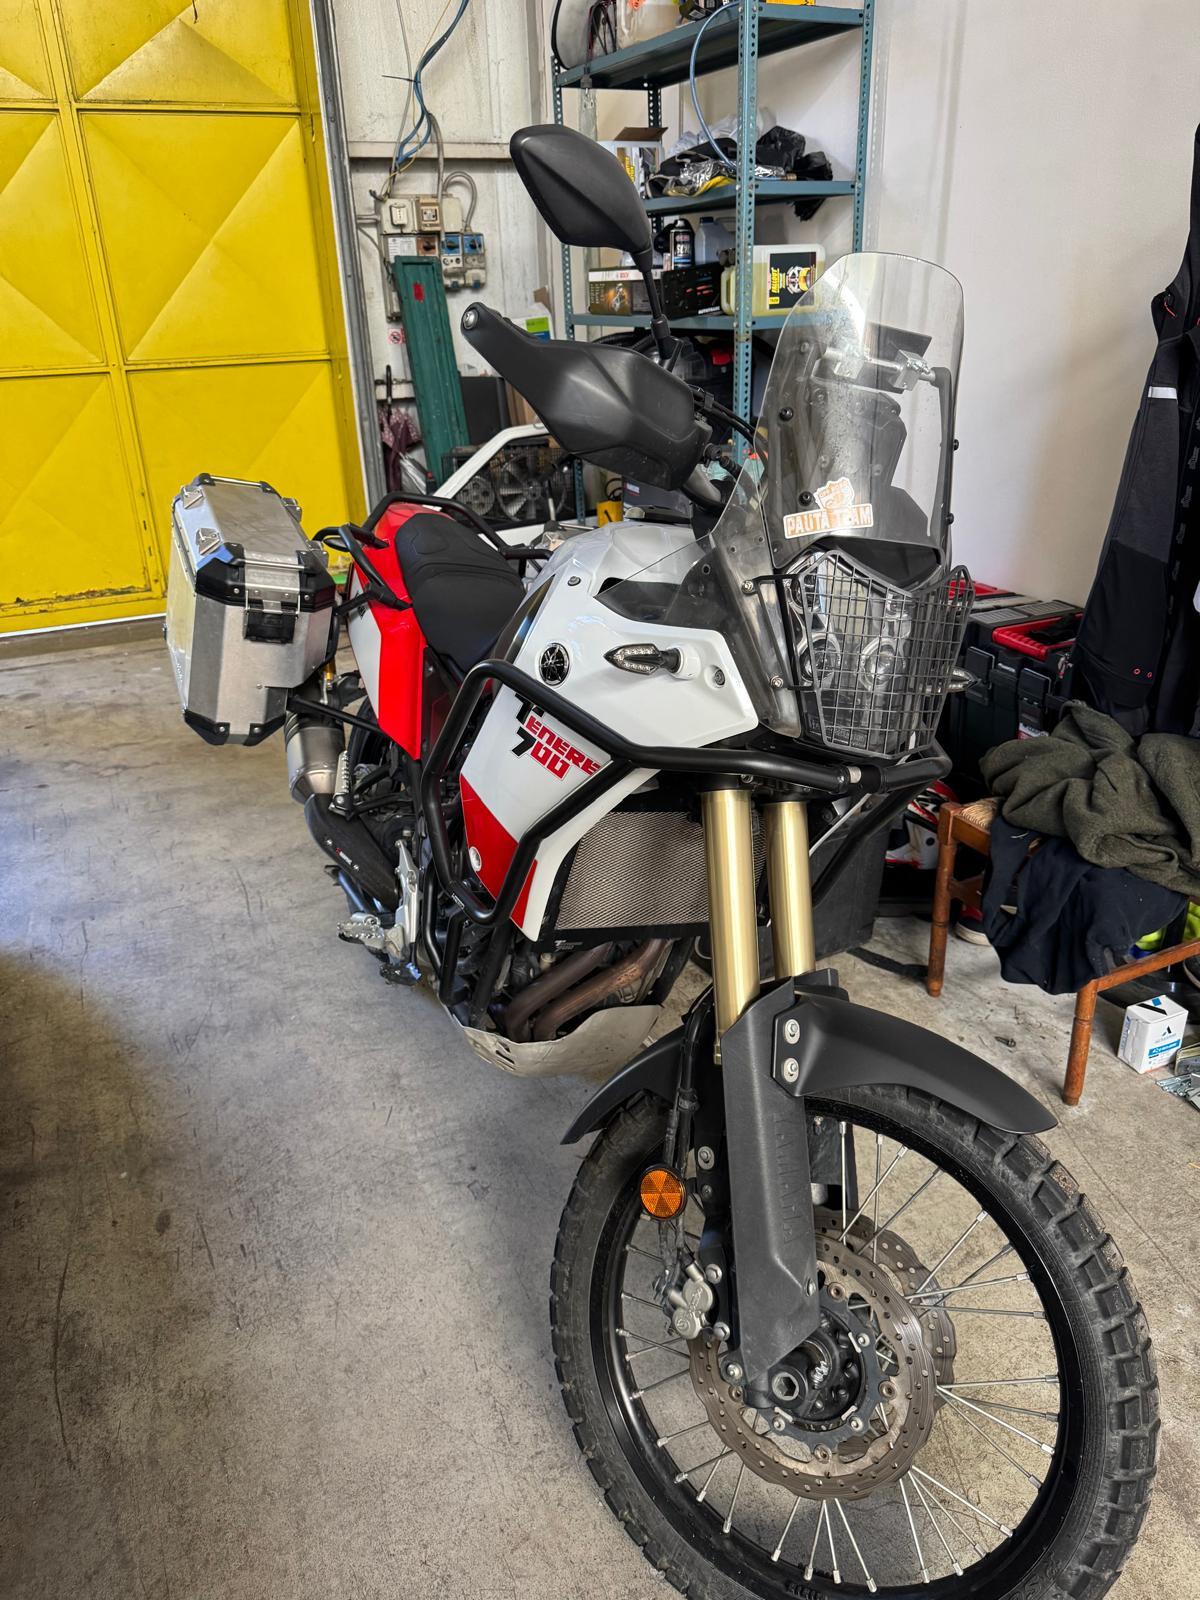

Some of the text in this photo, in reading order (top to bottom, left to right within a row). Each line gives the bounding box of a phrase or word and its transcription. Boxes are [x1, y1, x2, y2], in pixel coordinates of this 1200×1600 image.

[787, 505, 872, 536] PAUTA TAM
[511, 726, 571, 781] 700
